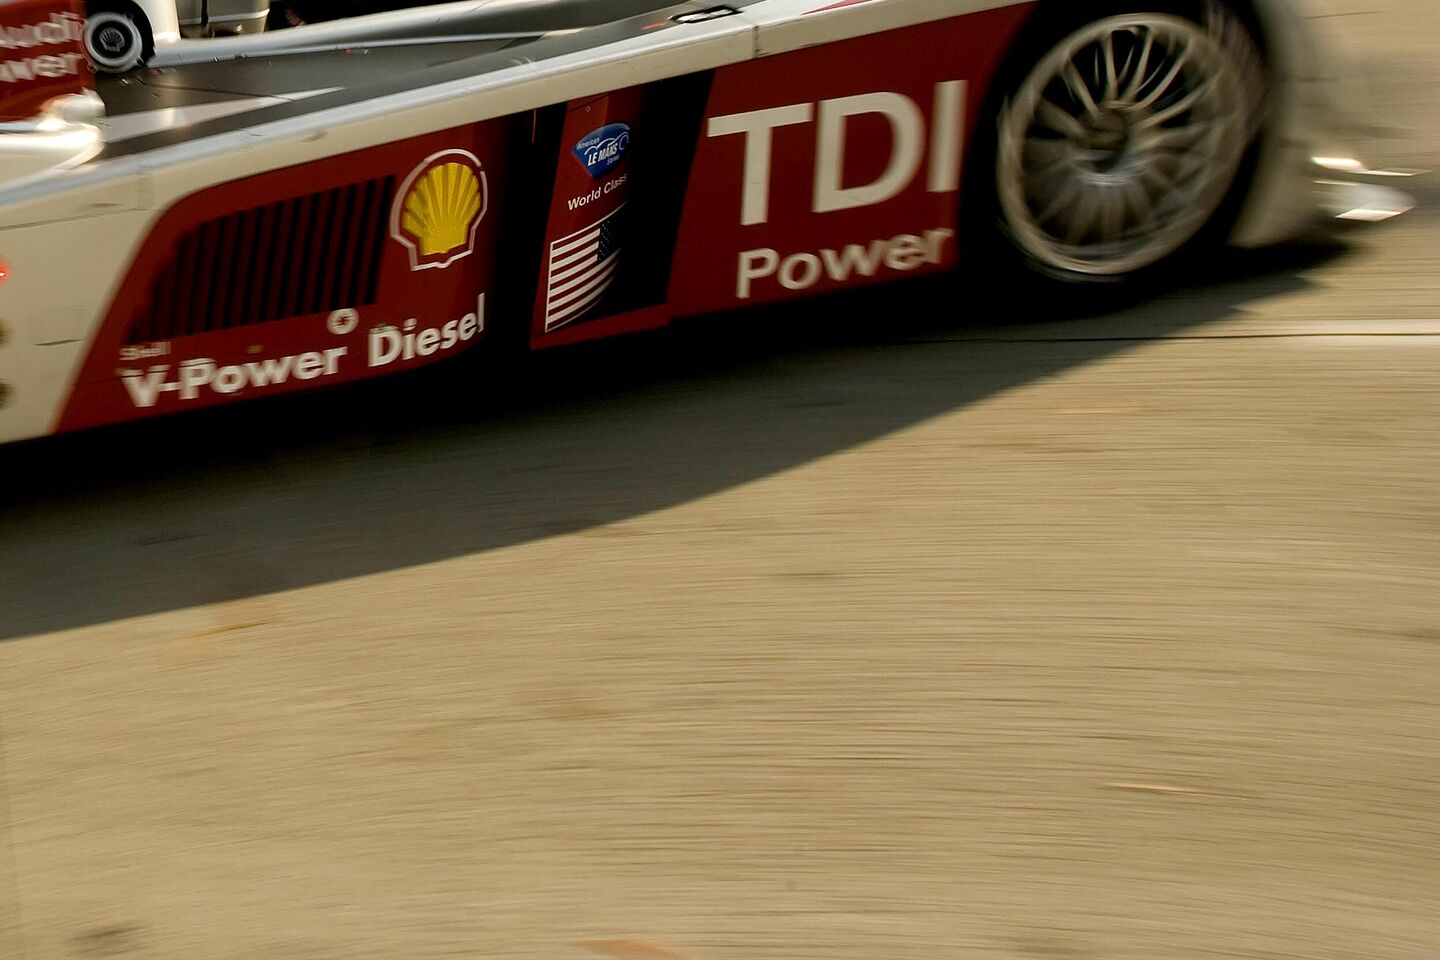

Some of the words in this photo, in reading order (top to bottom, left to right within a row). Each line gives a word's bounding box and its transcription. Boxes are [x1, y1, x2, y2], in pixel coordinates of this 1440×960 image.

[588, 151, 598, 166] LE
[706, 79, 968, 226] TDI
[568, 187, 601, 210] World
[604, 174, 628, 194] Class
[736, 227, 954, 299] Power
[121, 345, 348, 408] V-Power
[368, 292, 486, 368] Diesel
